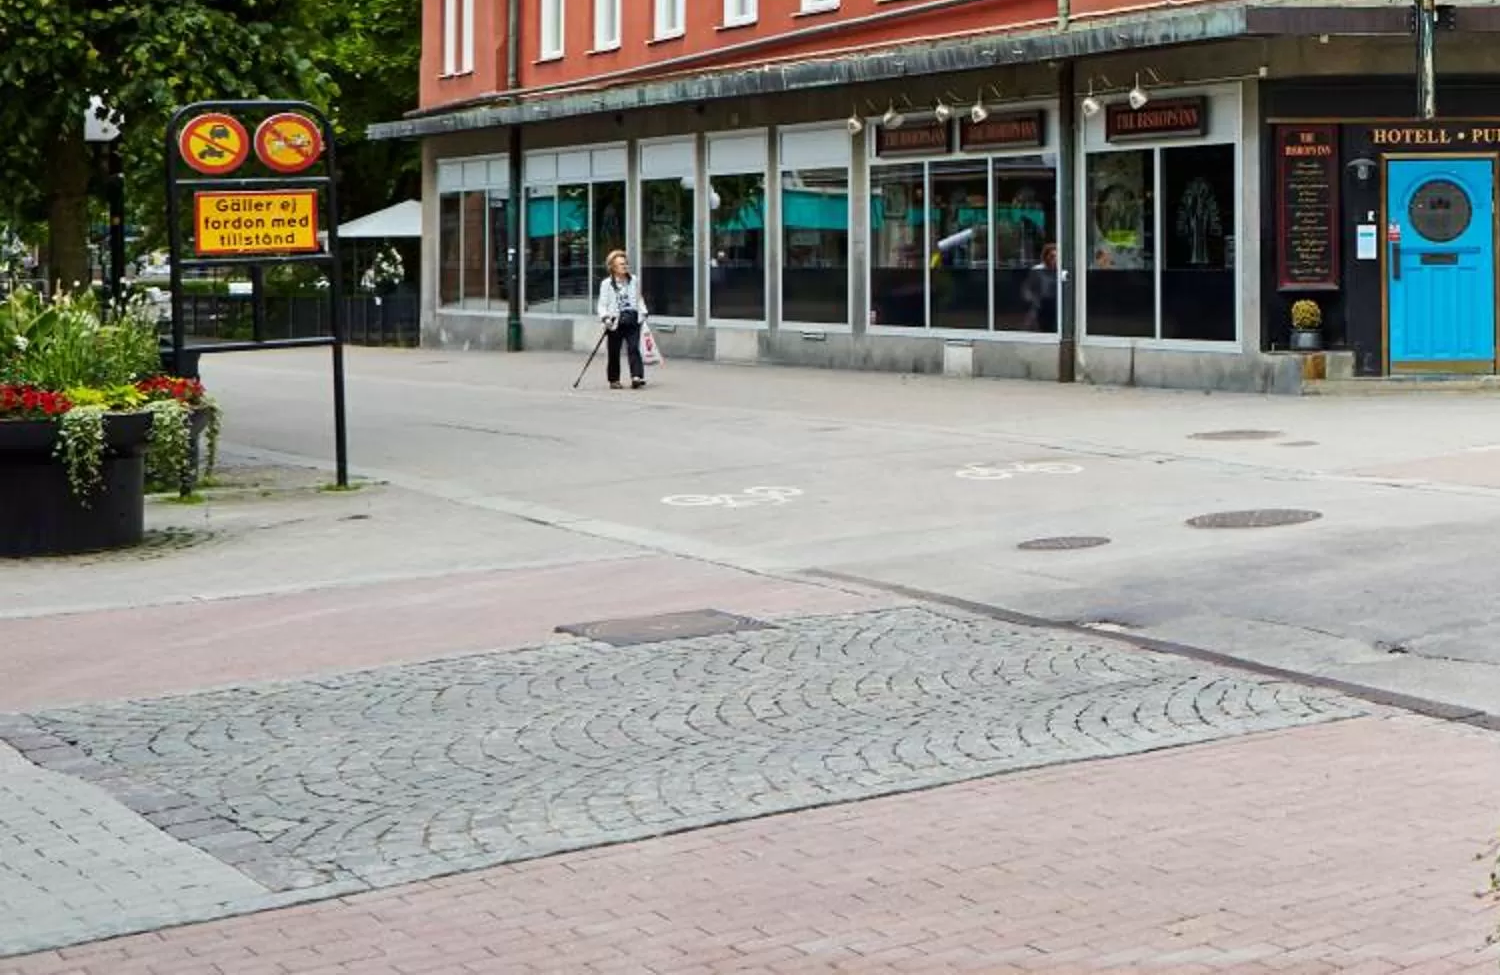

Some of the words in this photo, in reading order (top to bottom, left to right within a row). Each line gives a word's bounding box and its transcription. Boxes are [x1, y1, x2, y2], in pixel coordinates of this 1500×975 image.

[1117, 112, 1136, 129] THE
[1373, 128, 1452, 144] HOTELL
[215, 198, 273, 212] Gäller
[280, 199, 298, 213] ej
[204, 216, 265, 230] fordon
[271, 215, 309, 228] med
[219, 232, 295, 246] tillstånd
